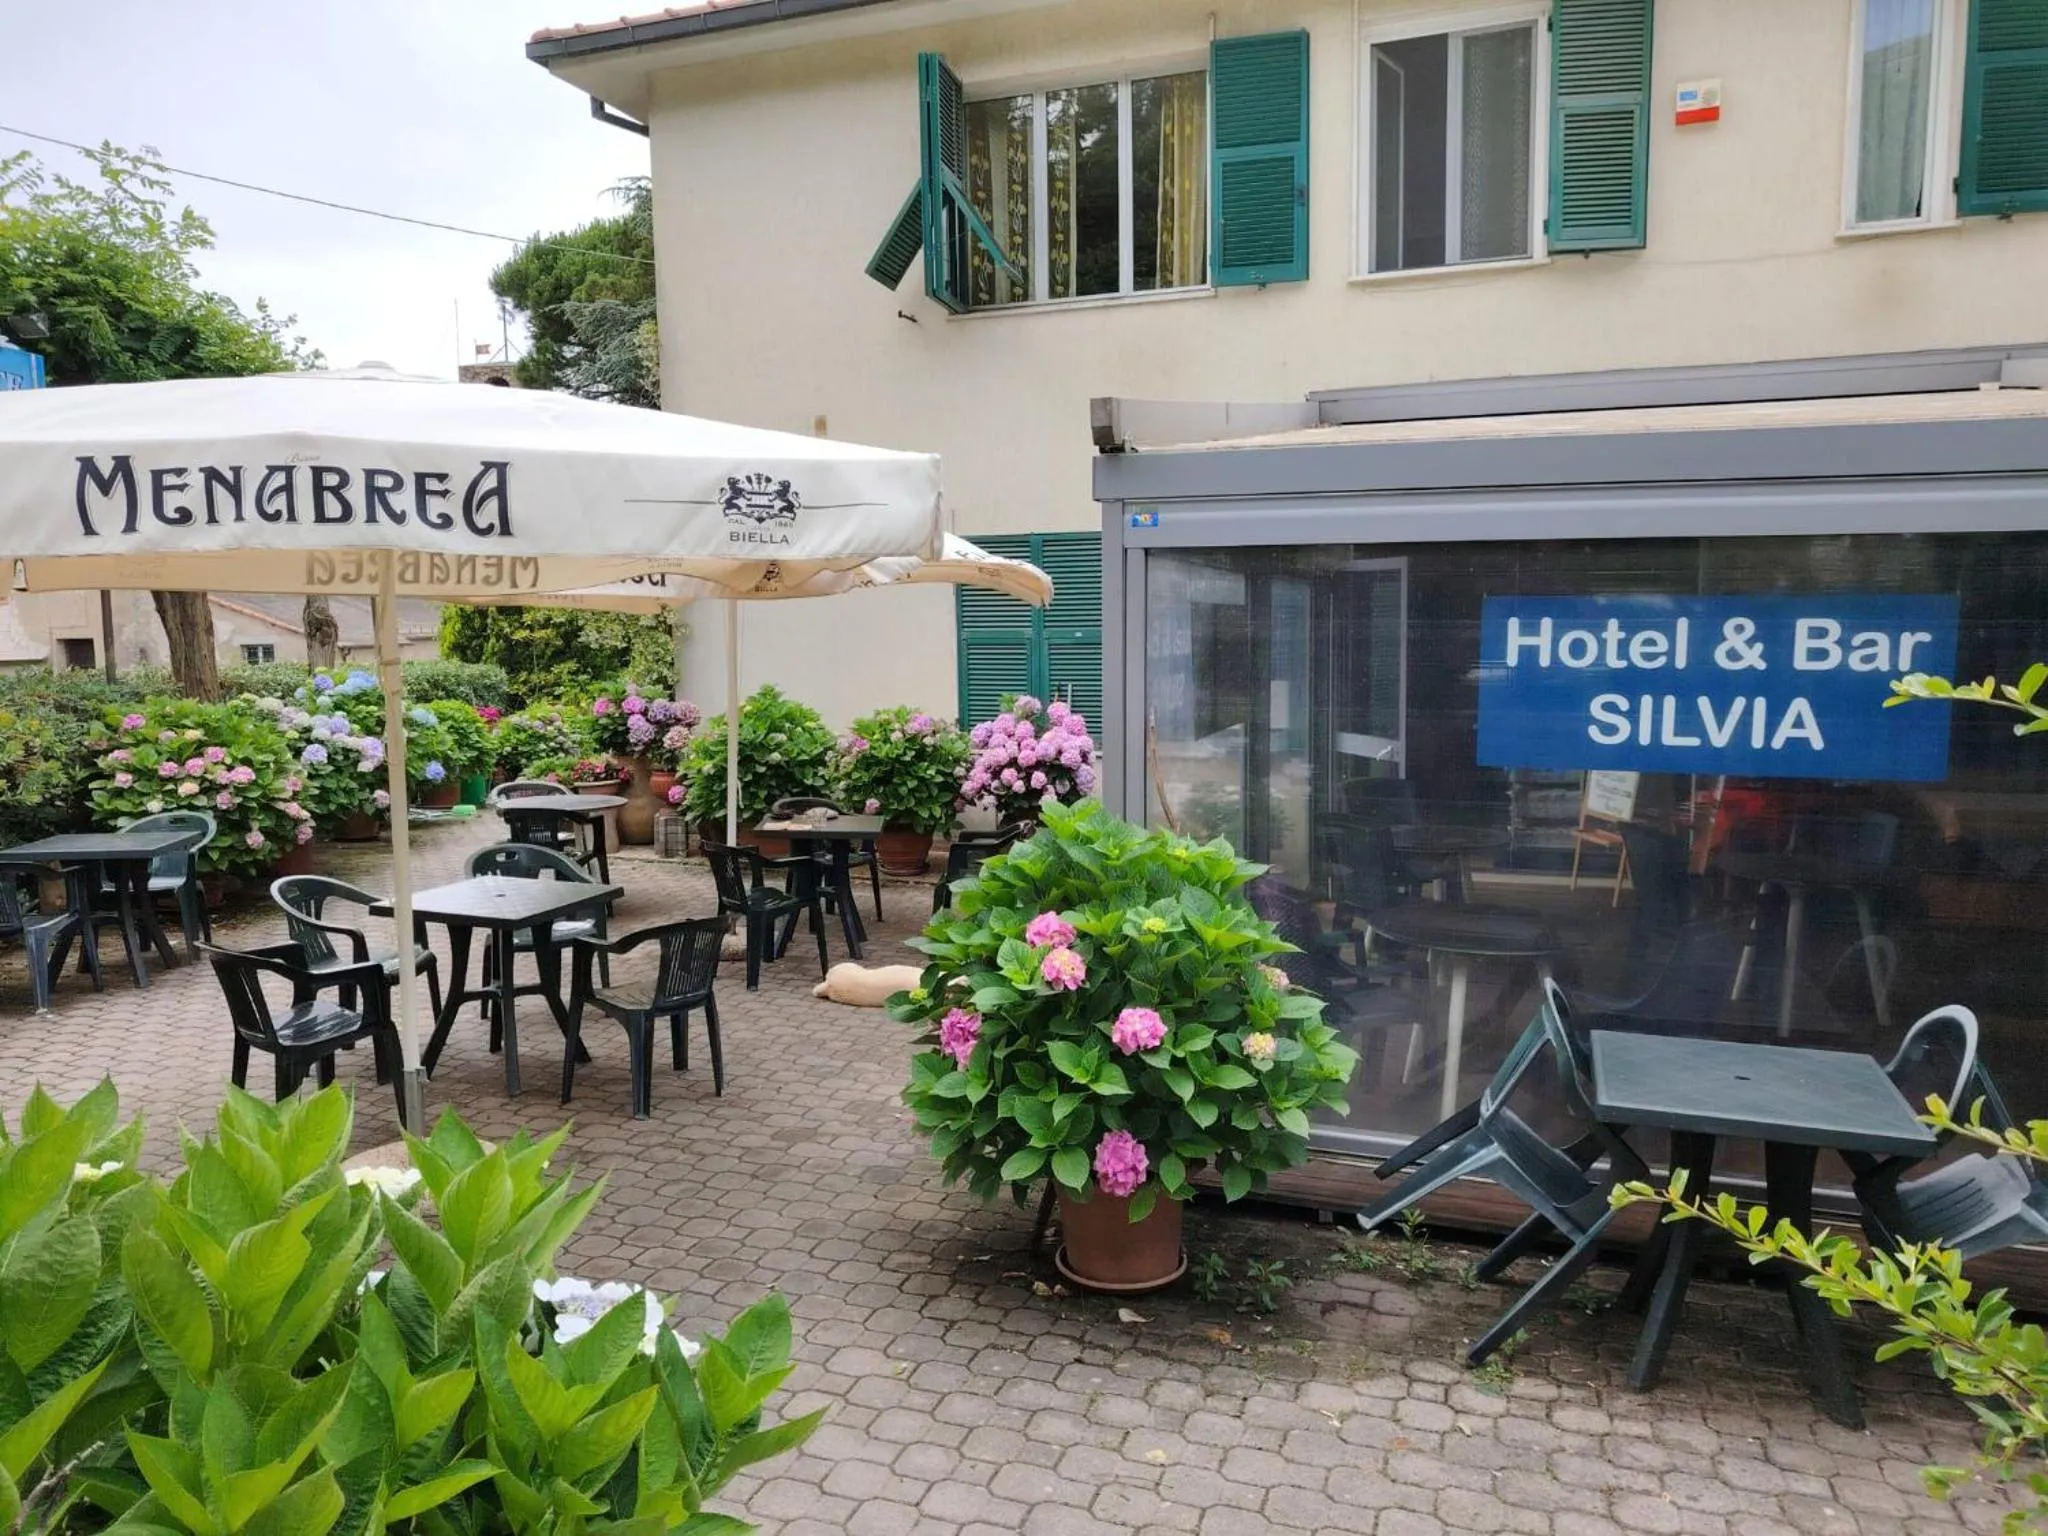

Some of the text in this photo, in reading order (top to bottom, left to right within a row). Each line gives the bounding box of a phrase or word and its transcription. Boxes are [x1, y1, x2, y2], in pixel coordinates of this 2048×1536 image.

[75, 455, 515, 537] MENABREA
[729, 531, 789, 545] BIELLA
[1506, 616, 1933, 672] Hotel & Bar
[1588, 693, 1825, 751] SILVIA
